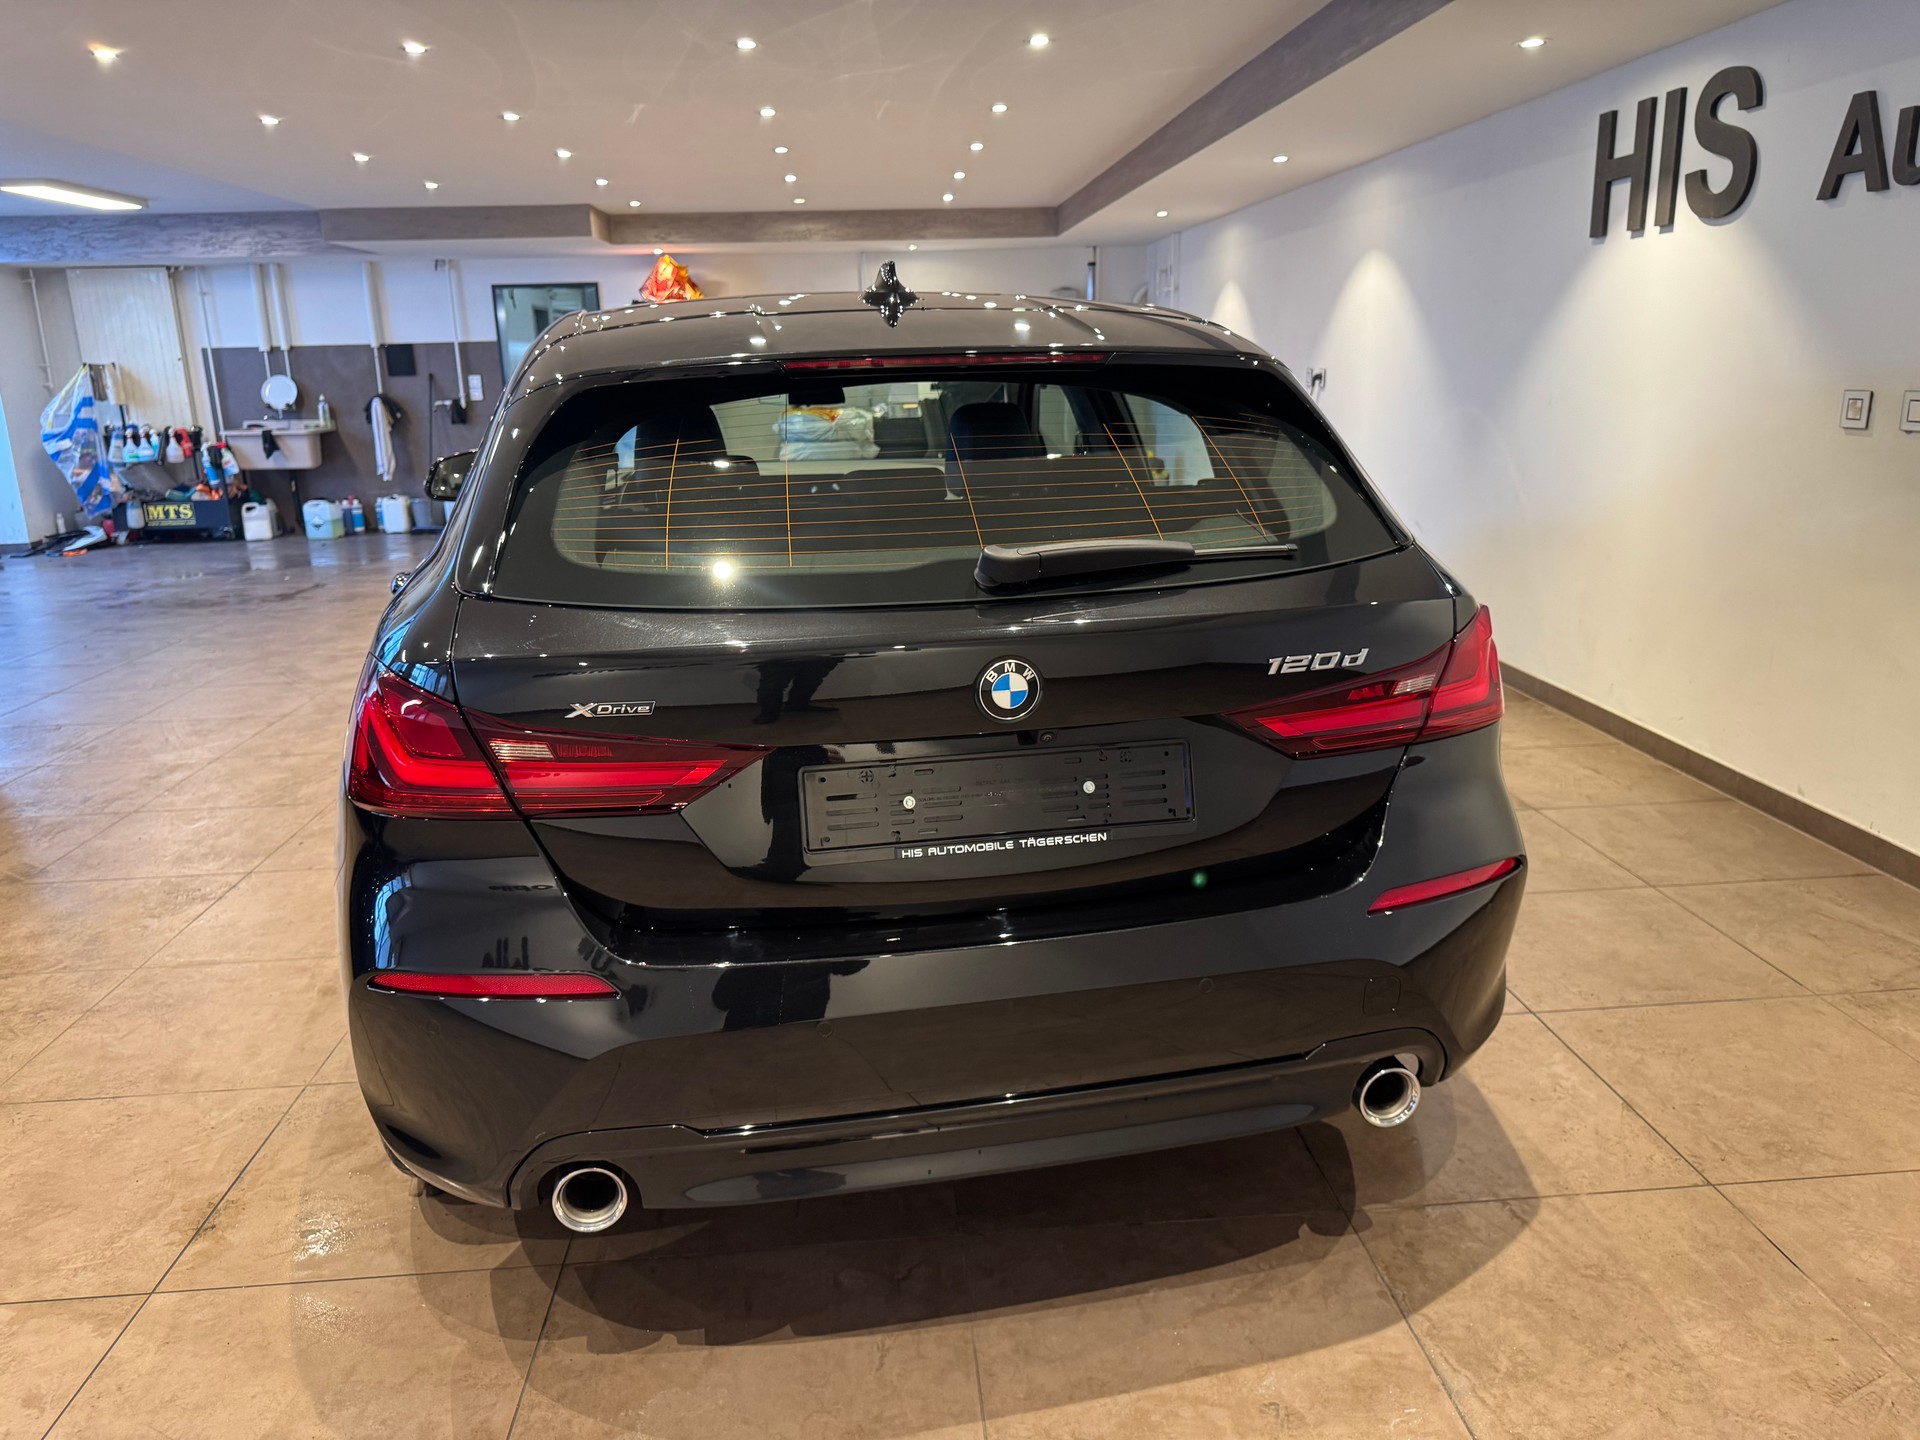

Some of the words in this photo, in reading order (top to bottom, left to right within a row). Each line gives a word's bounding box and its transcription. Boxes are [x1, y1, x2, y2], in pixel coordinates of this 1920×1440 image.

[1589, 65, 1764, 238] HIS
[147, 503, 193, 519] MTS
[985, 662, 1035, 683] BMW
[1267, 648, 1369, 676] 120d
[901, 848, 923, 859] HIS
[927, 840, 1015, 857] AUTOMOBILE
[1018, 832, 1108, 849] TÄGERSCHEN
